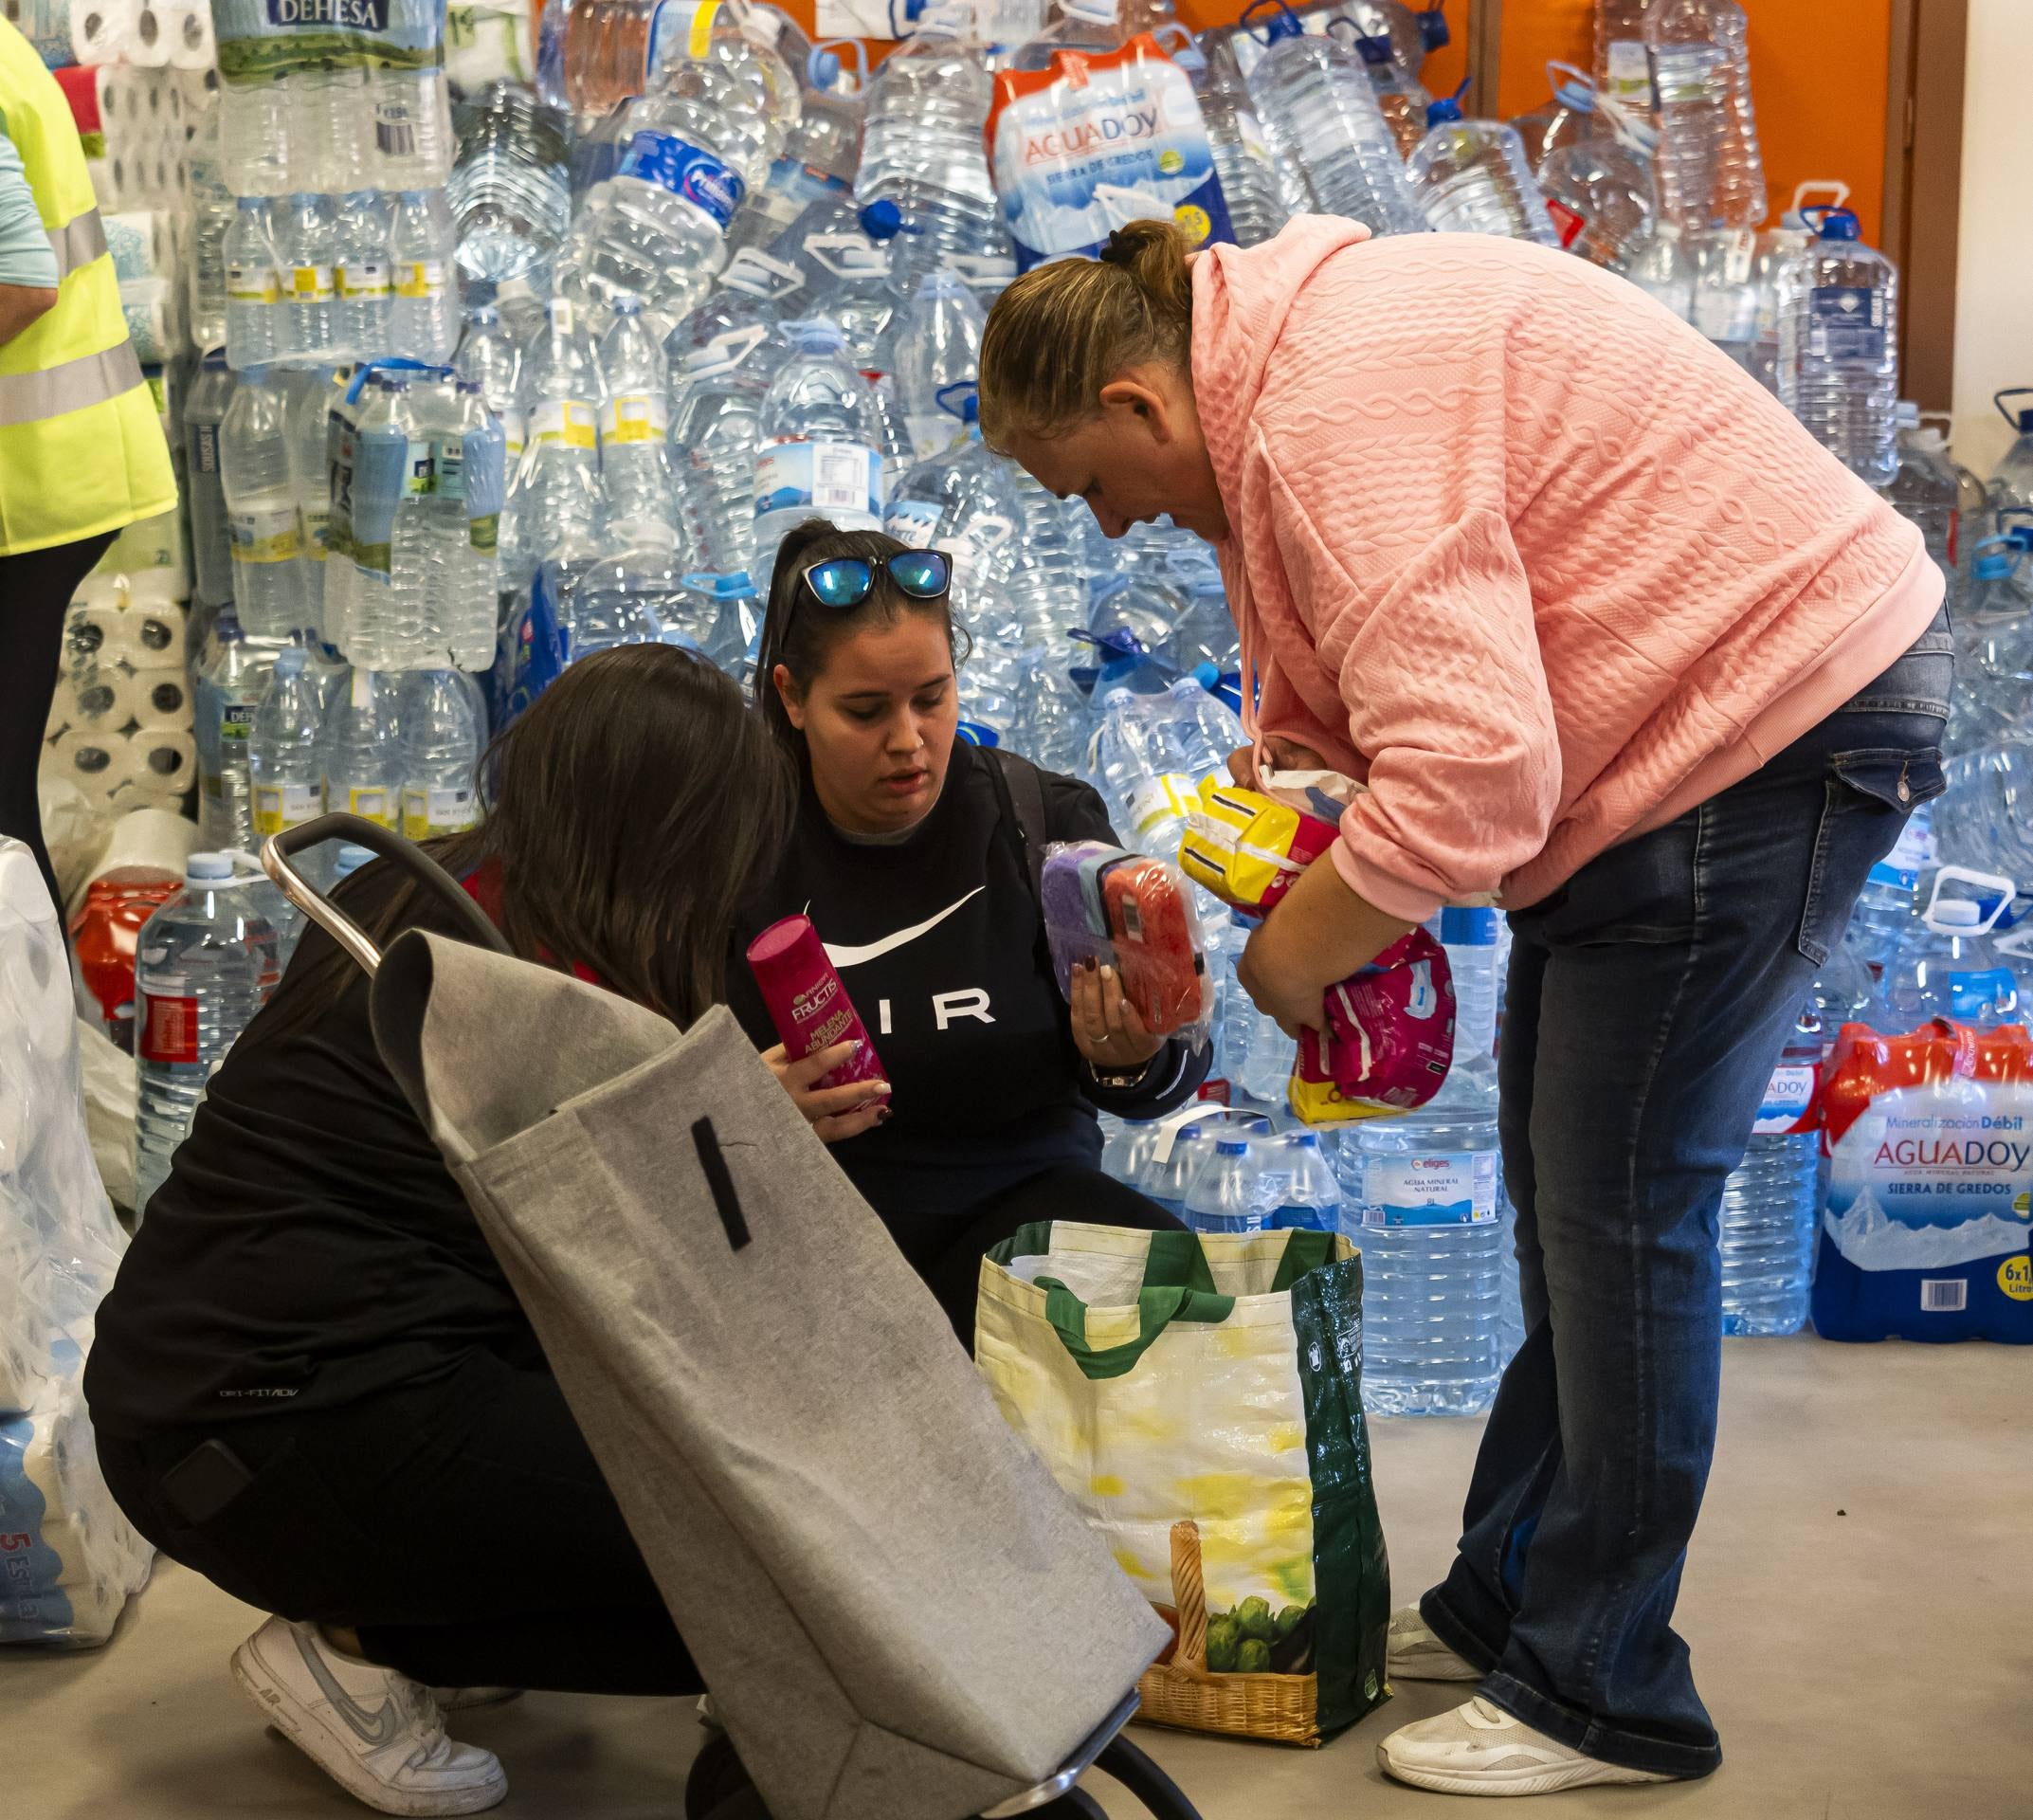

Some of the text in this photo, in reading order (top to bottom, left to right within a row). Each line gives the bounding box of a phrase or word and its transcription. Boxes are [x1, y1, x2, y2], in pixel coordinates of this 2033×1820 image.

[280, 0, 379, 28] DEHESA
[1026, 107, 1157, 163] AGUADOY
[791, 977, 838, 1021] FRUCTIS
[879, 988, 996, 1034] IR
[805, 1008, 854, 1054] ABUNDANTE
[809, 1010, 844, 1040] MELENA
[1768, 1082, 1808, 1097] ADOY
[1886, 1114, 2023, 1130] Mineralización Débil
[1423, 1158, 1450, 1170] eliges
[1874, 1139, 2030, 1173] AGUADOY
[1888, 1183, 2011, 1194] SIERRA DE GREDOS
